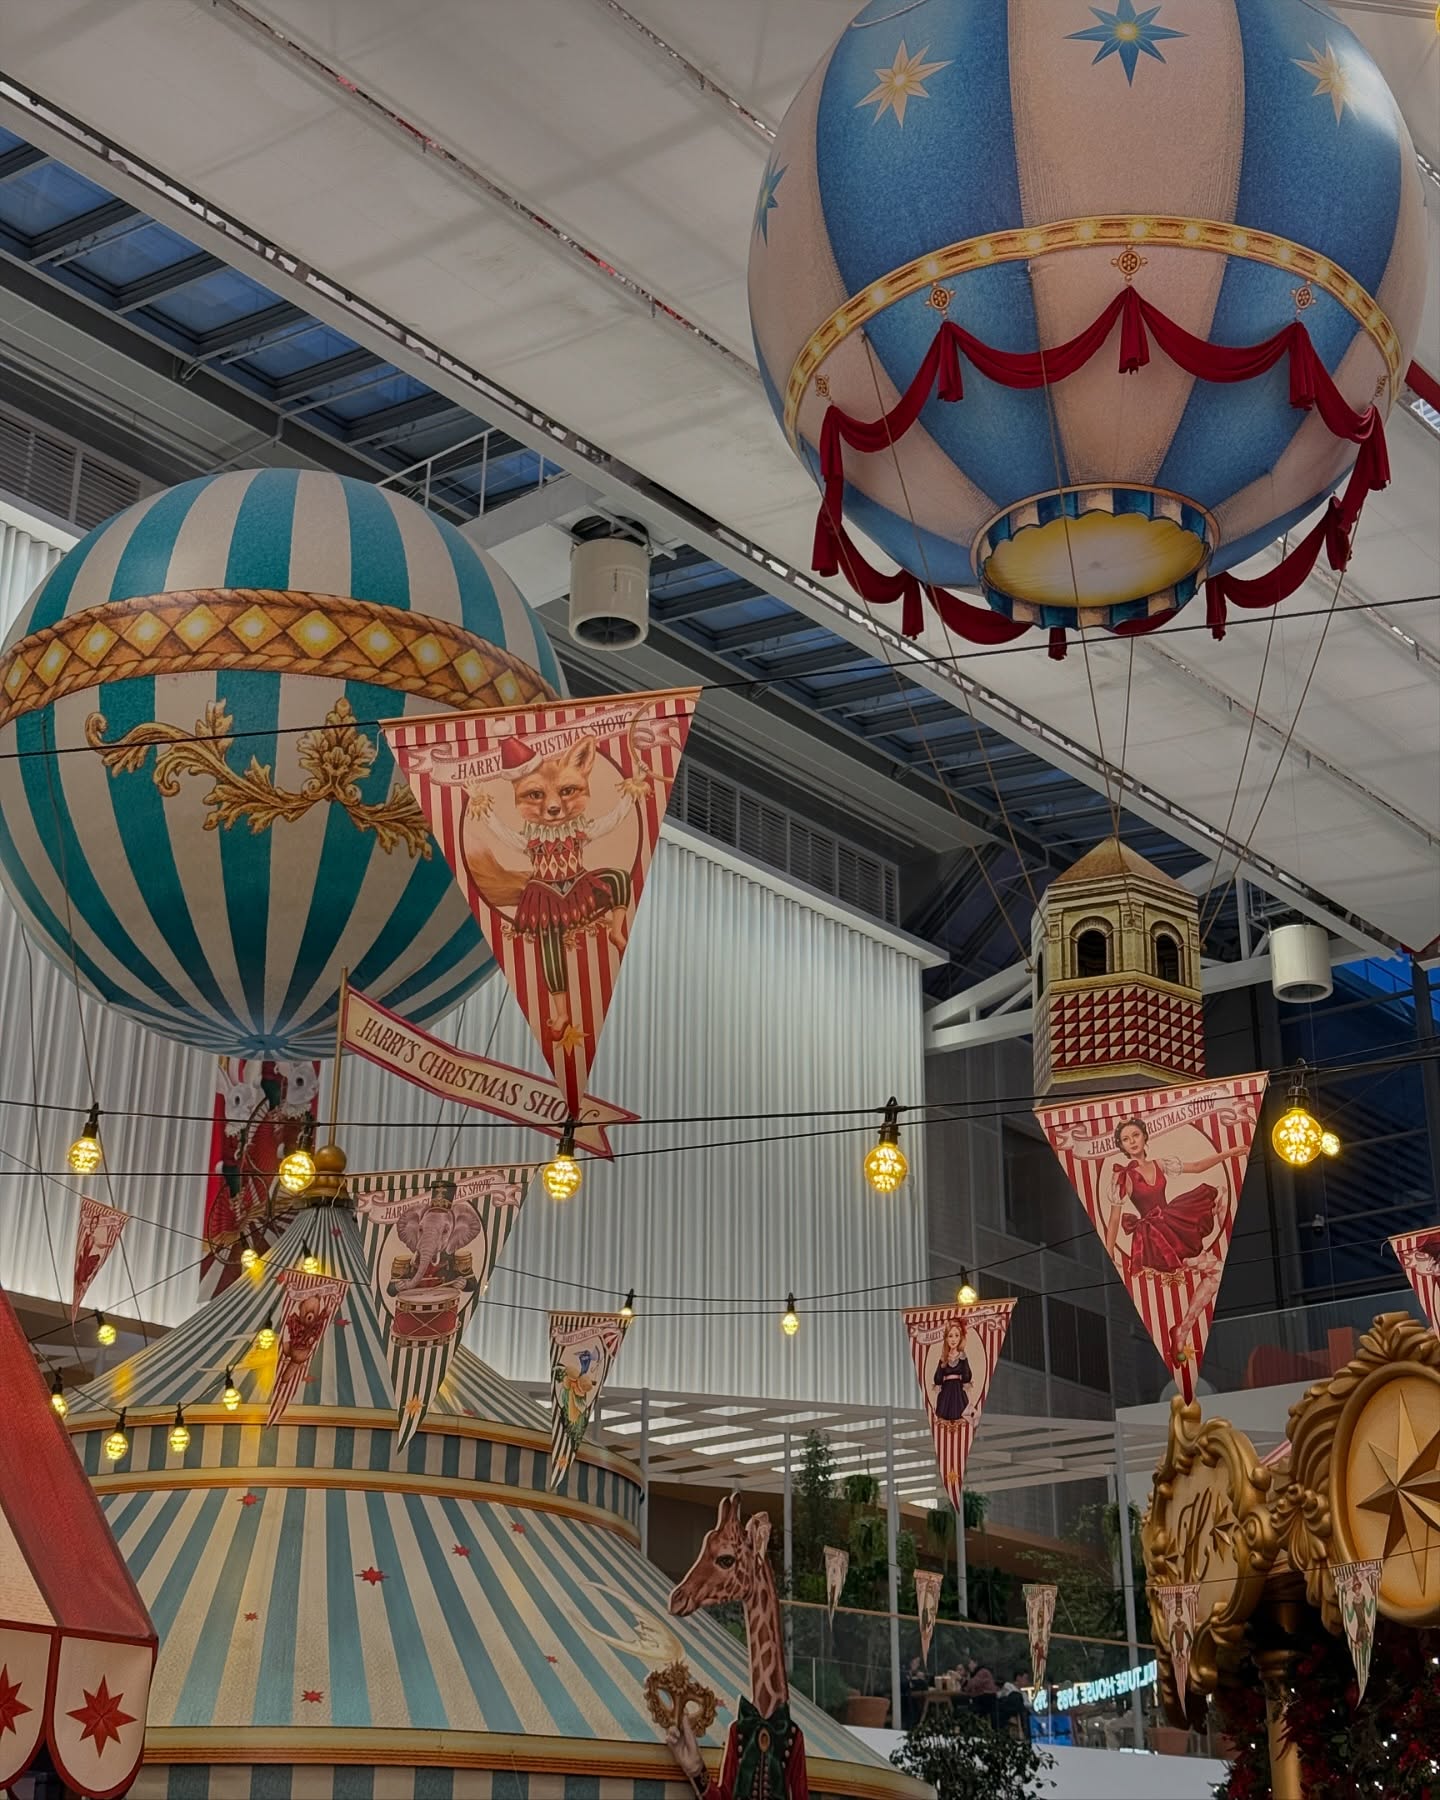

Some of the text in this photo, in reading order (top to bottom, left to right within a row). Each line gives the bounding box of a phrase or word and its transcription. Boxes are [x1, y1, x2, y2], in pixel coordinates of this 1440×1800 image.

[451, 754, 502, 780] HARRY
[590, 711, 633, 738] SHOW
[356, 1017, 420, 1063] HARRY'S
[418, 1051, 524, 1106] CHRISTMAS
[1188, 1092, 1218, 1118] SHOW
